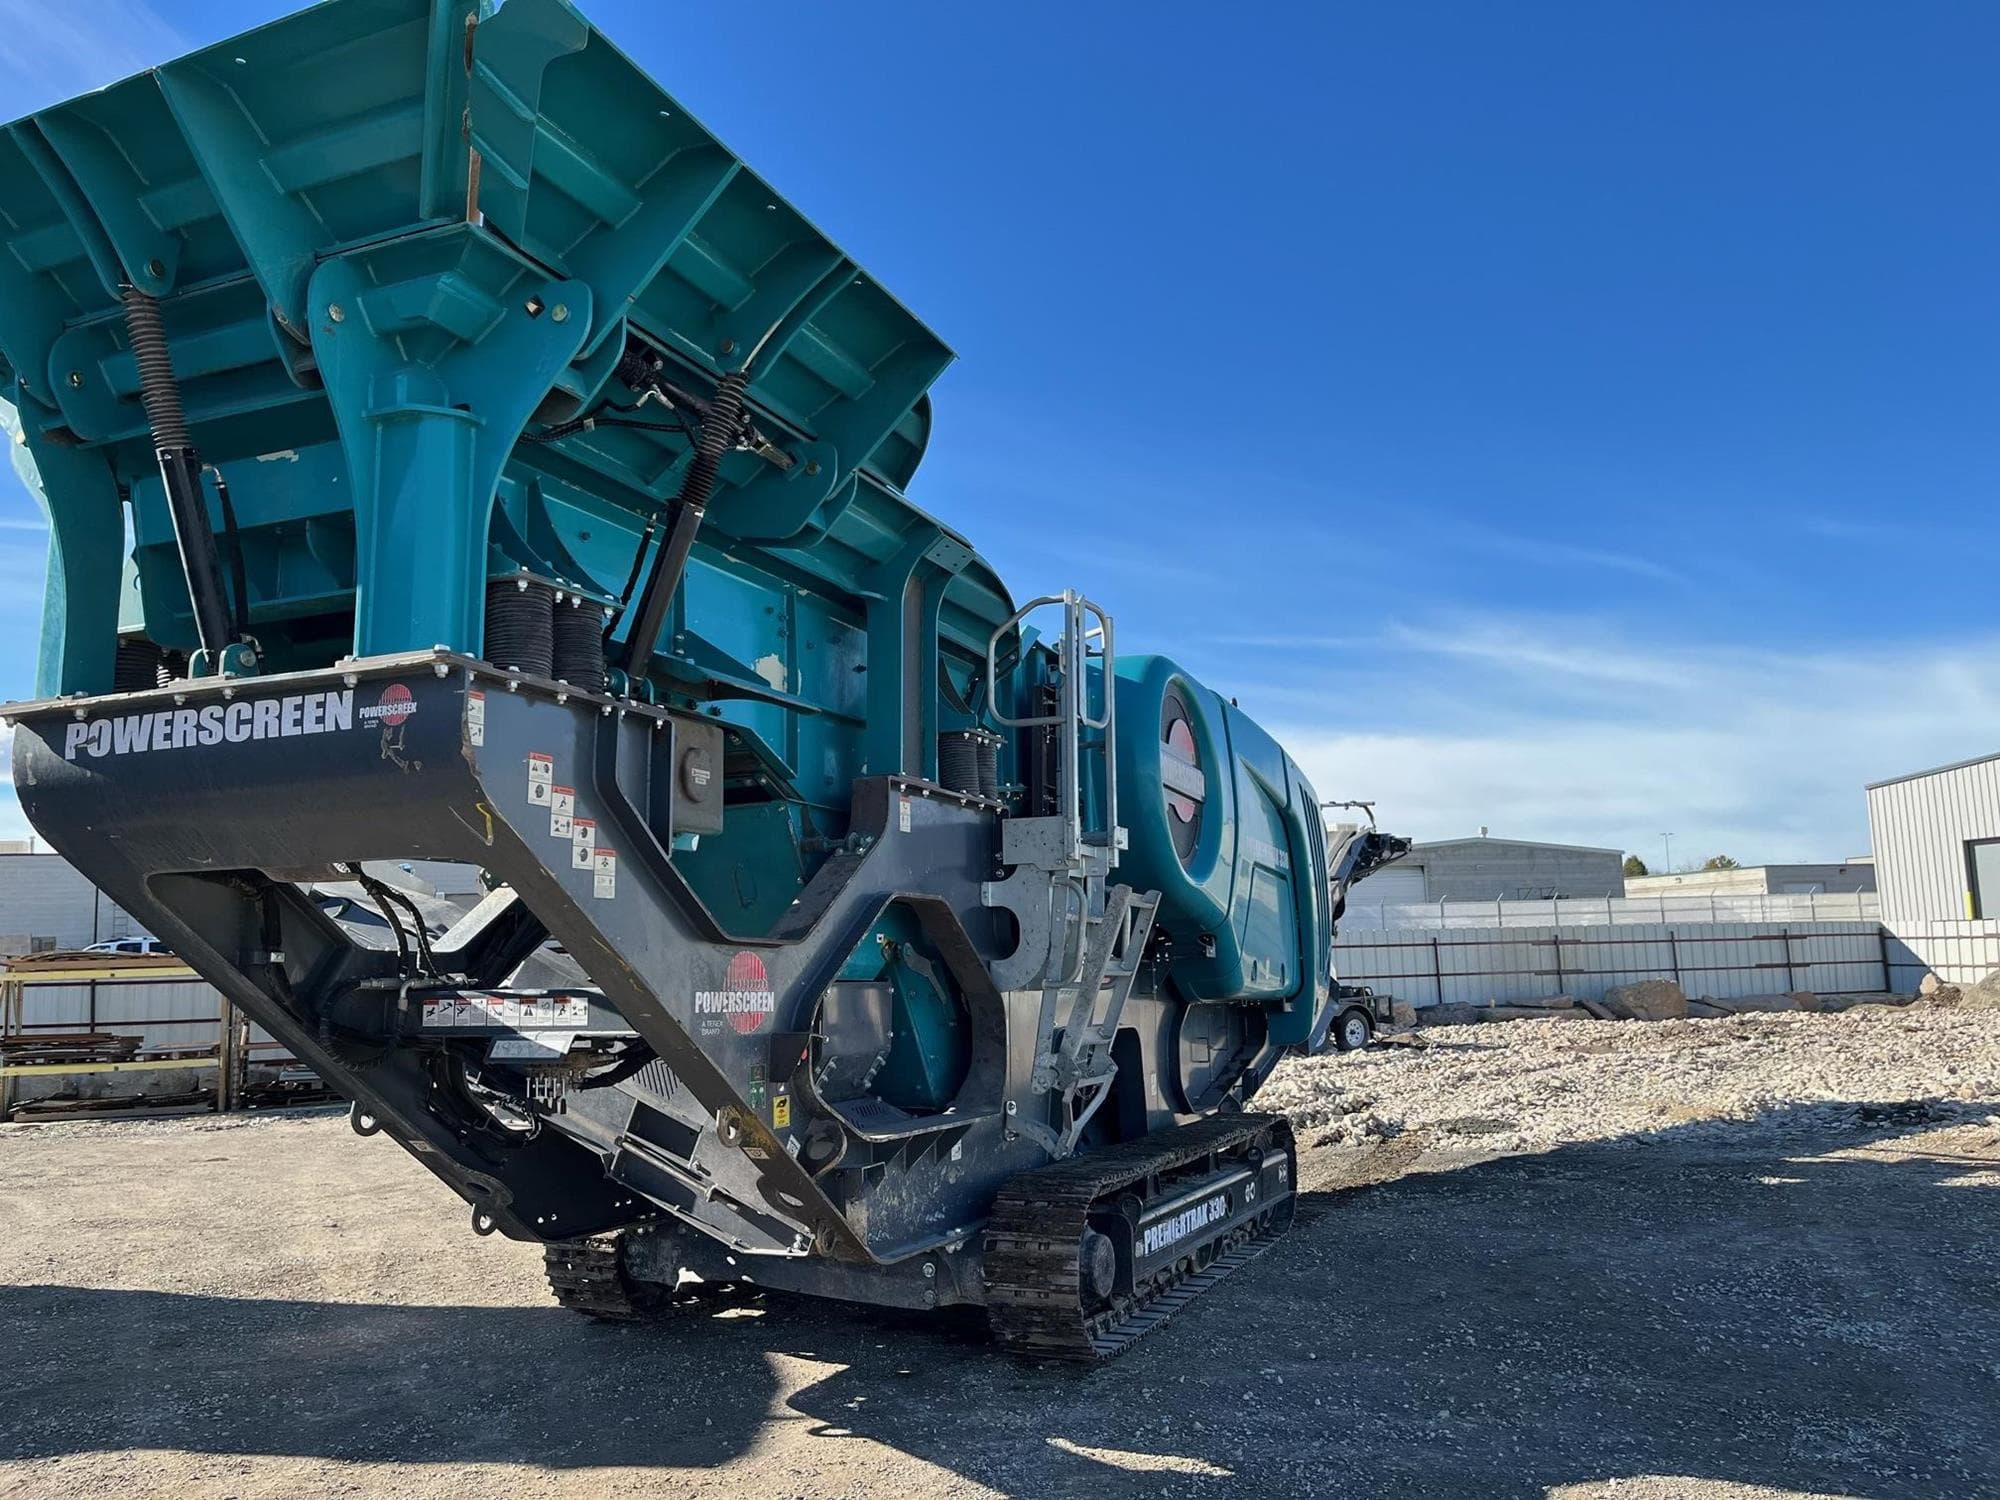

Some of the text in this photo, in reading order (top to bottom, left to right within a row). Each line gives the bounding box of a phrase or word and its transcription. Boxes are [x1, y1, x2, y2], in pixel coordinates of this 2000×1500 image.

[359, 702, 417, 718] POWERSCREEN
[65, 689, 354, 760] POWERSCREEN
[695, 991, 775, 1014] POWERSCREEN
